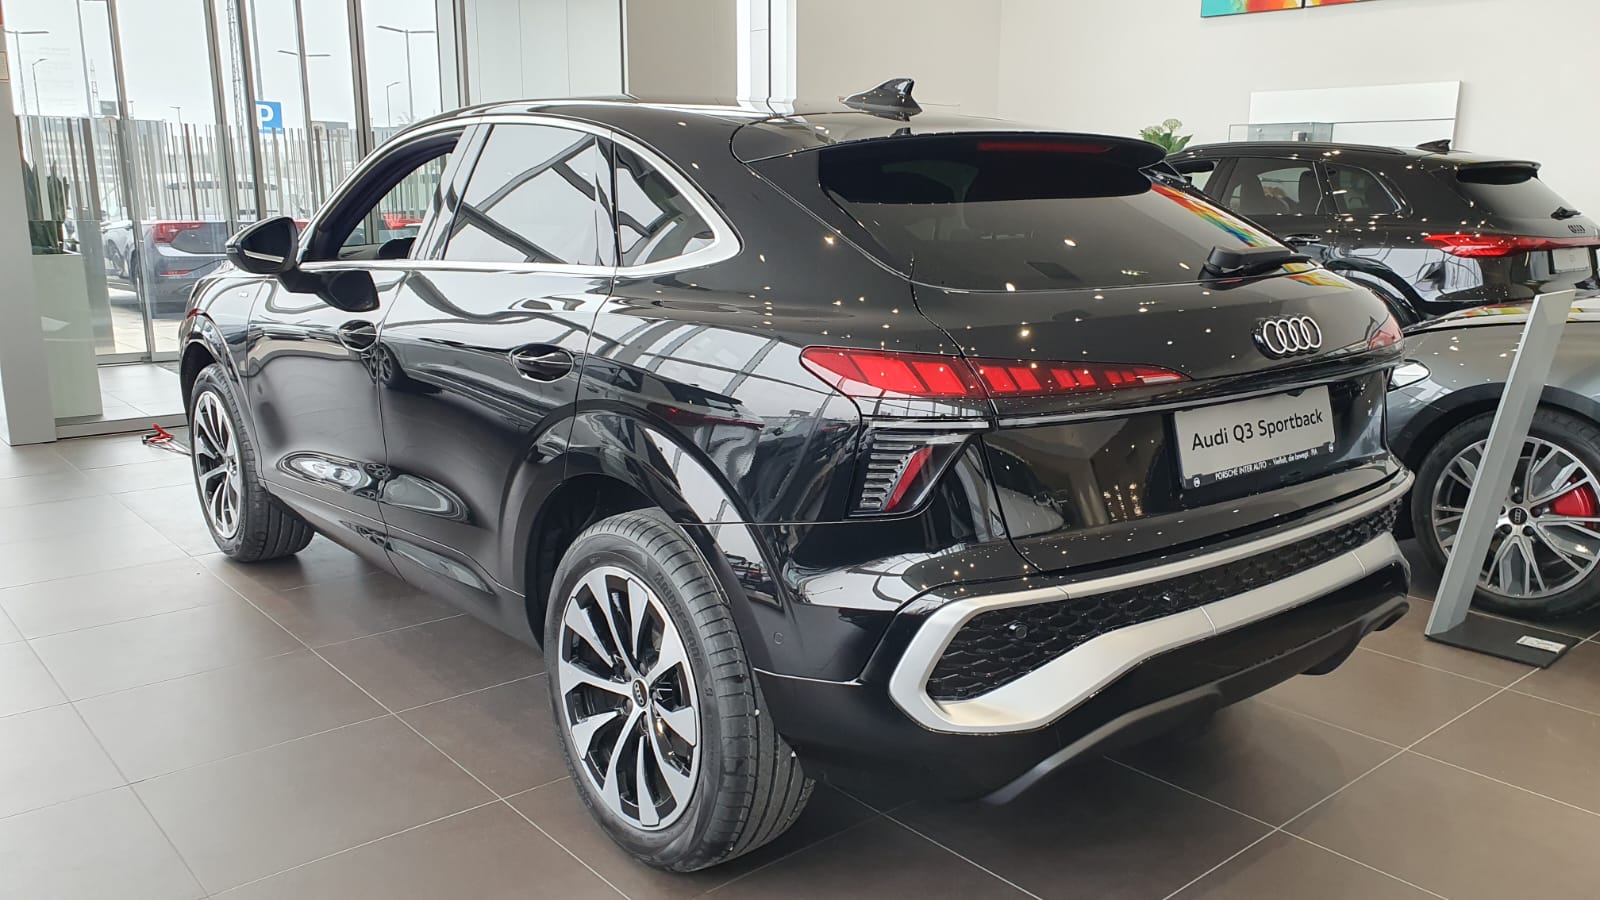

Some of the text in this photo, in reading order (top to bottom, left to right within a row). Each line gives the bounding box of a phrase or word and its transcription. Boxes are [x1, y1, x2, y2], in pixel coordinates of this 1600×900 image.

[255, 104, 274, 130] P
[1192, 408, 1323, 451] Audi Q3 Sportback
[1215, 469, 1239, 481] PORSCHE
[1239, 465, 1253, 475] INTER
[1253, 461, 1267, 472] AUTO
